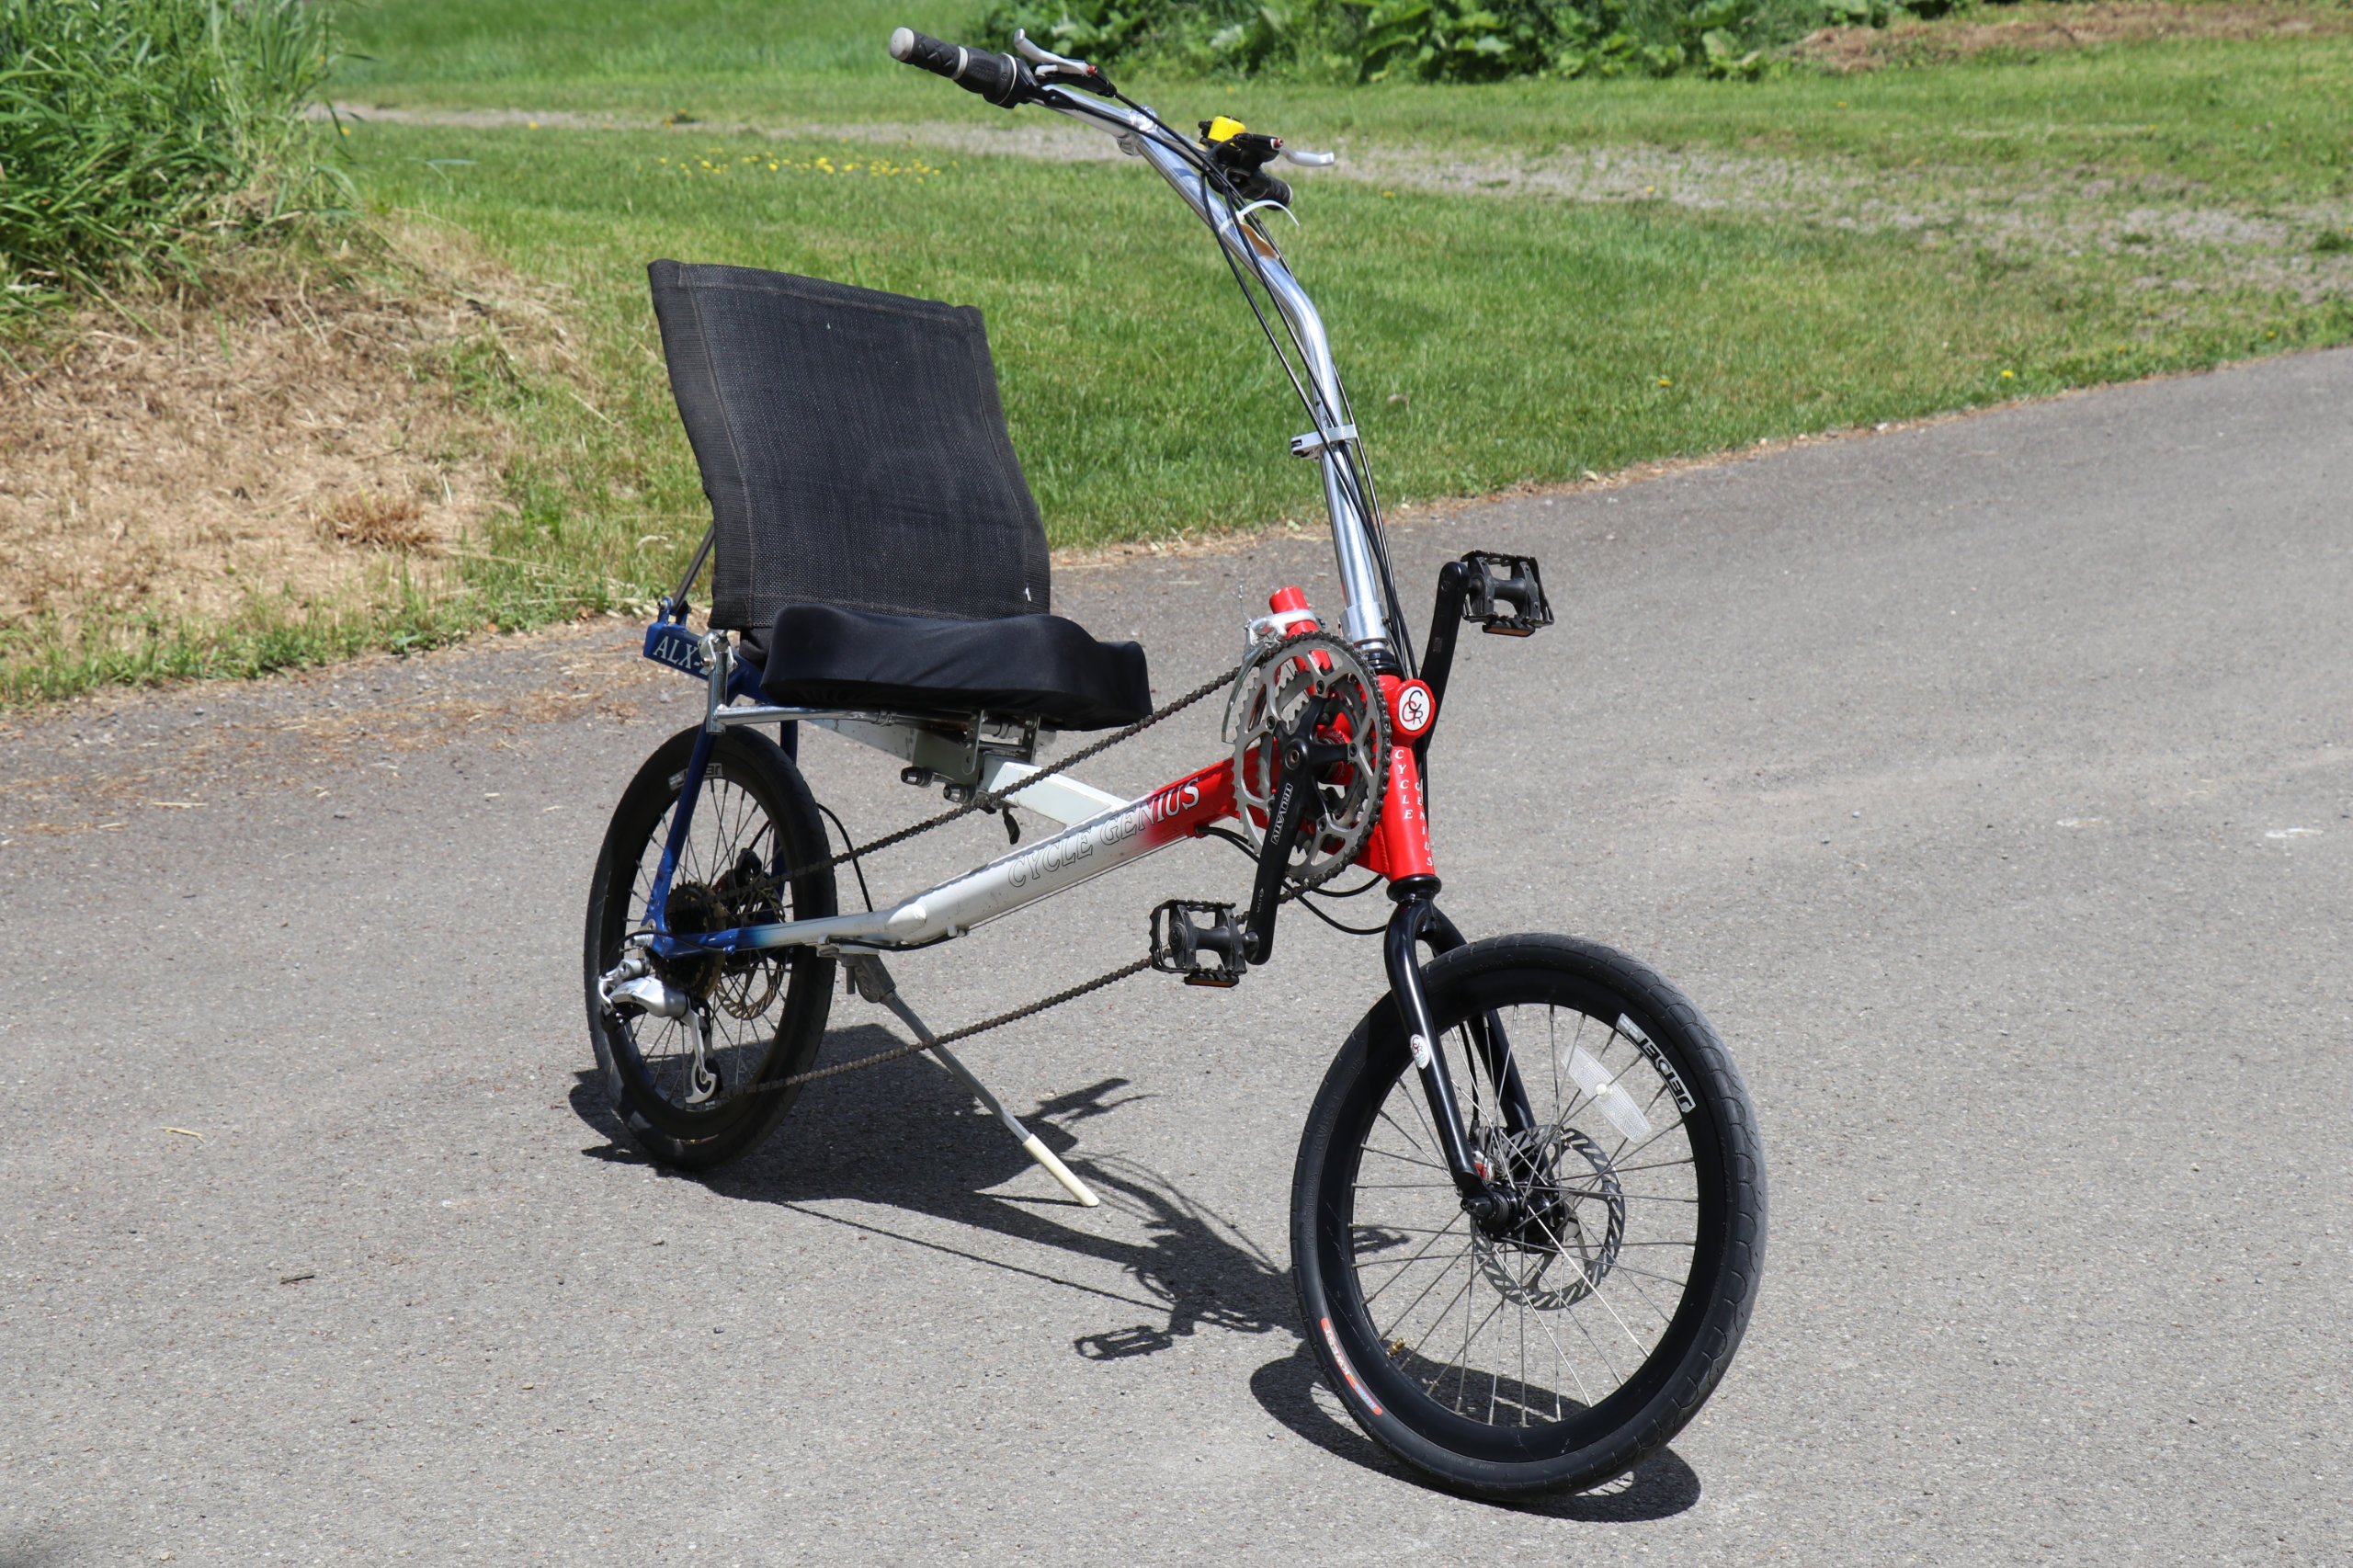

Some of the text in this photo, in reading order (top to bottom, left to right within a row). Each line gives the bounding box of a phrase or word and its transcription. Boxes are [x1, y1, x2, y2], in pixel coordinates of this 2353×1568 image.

[653, 635, 710, 676] ALX-
[1271, 782, 1293, 845] TRUVATIV
[1395, 749, 1414, 819] CYCLE
[1008, 777, 1199, 888] CYCLE GENIUS
[1415, 781, 1434, 867] GENIUS
[1627, 1032, 1693, 1108] JETSET
